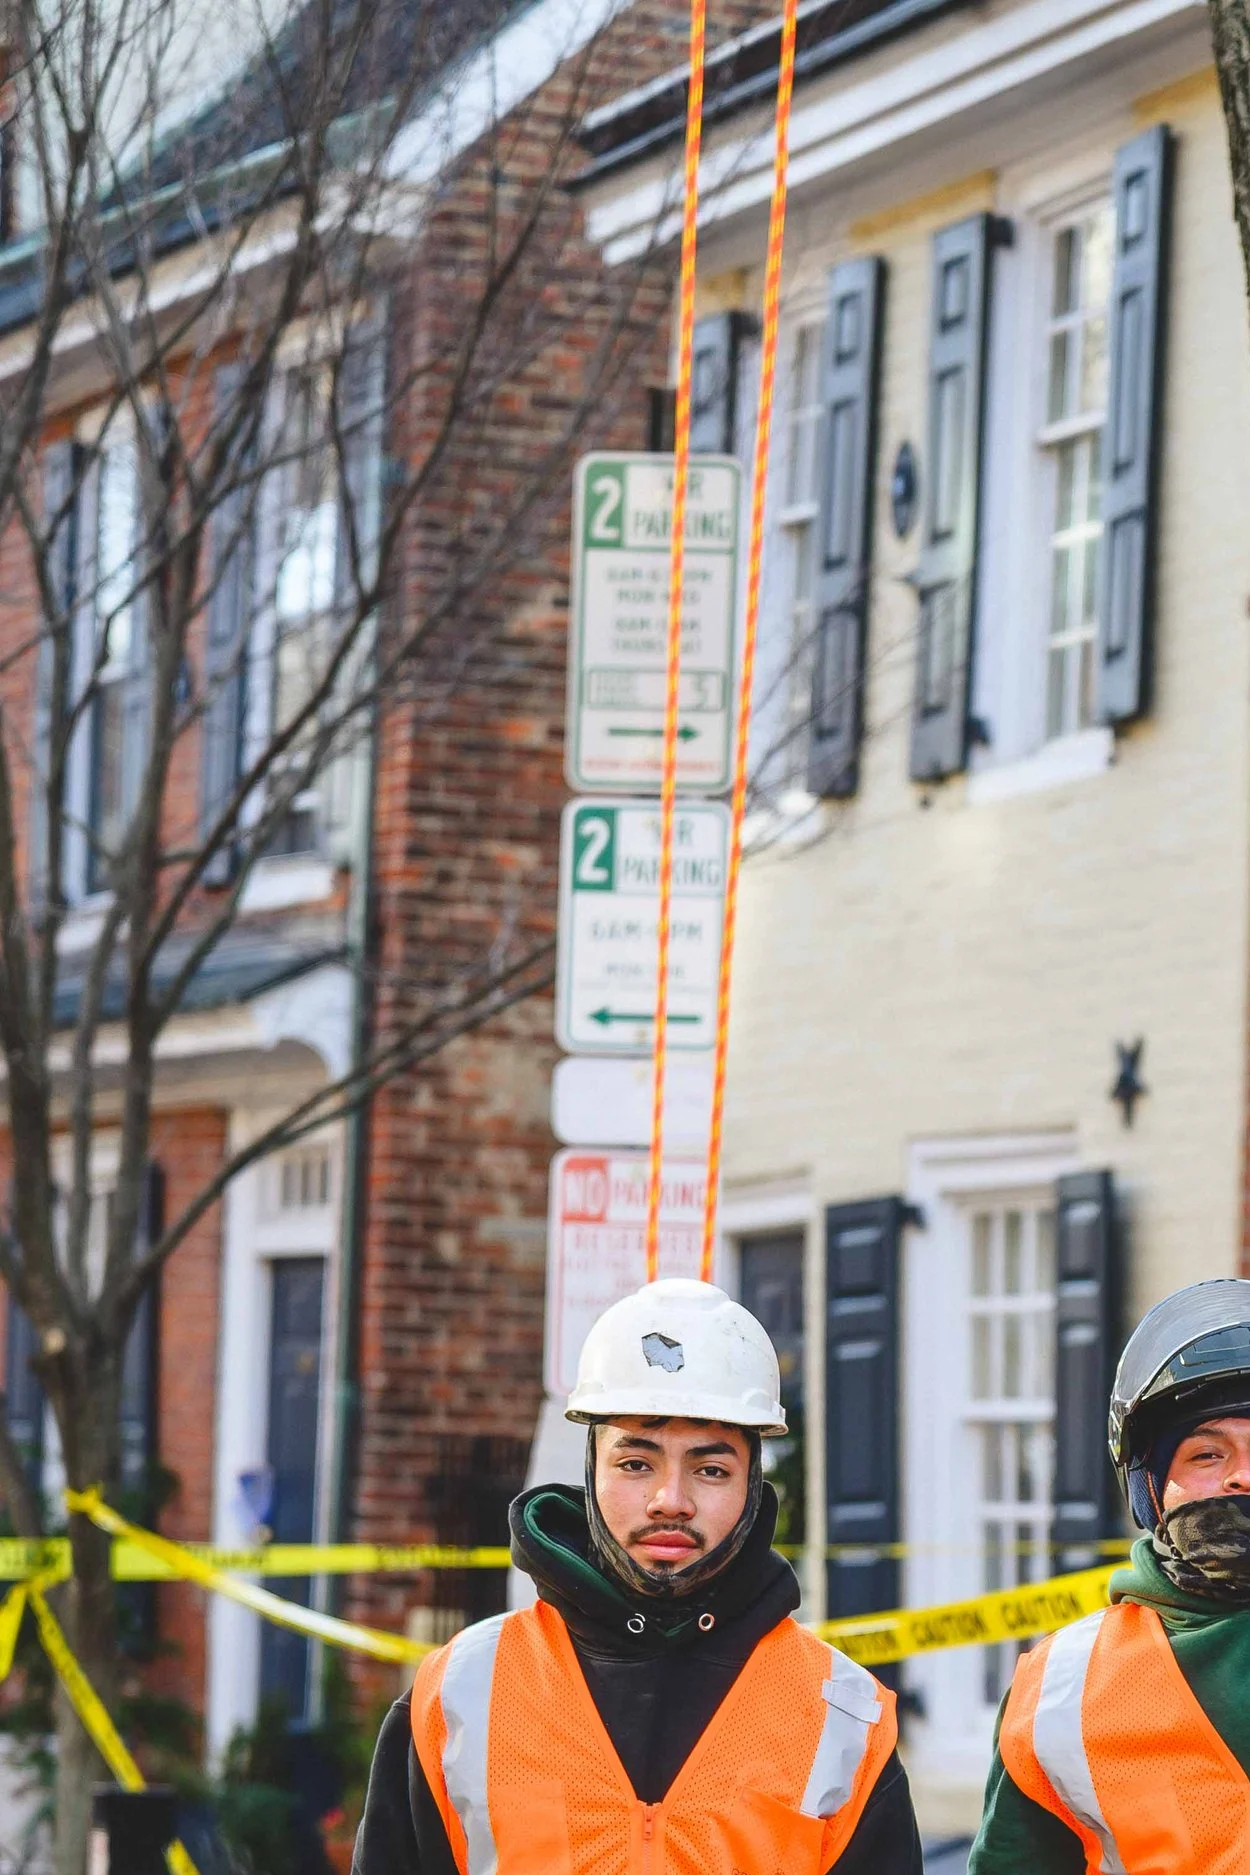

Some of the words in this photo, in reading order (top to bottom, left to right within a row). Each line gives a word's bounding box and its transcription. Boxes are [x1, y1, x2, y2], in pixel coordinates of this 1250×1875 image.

[591, 474, 621, 540] 2
[577, 816, 610, 882] 2
[910, 1611, 988, 1647] CAUTION
[1001, 1591, 1083, 1631] CAUTION
